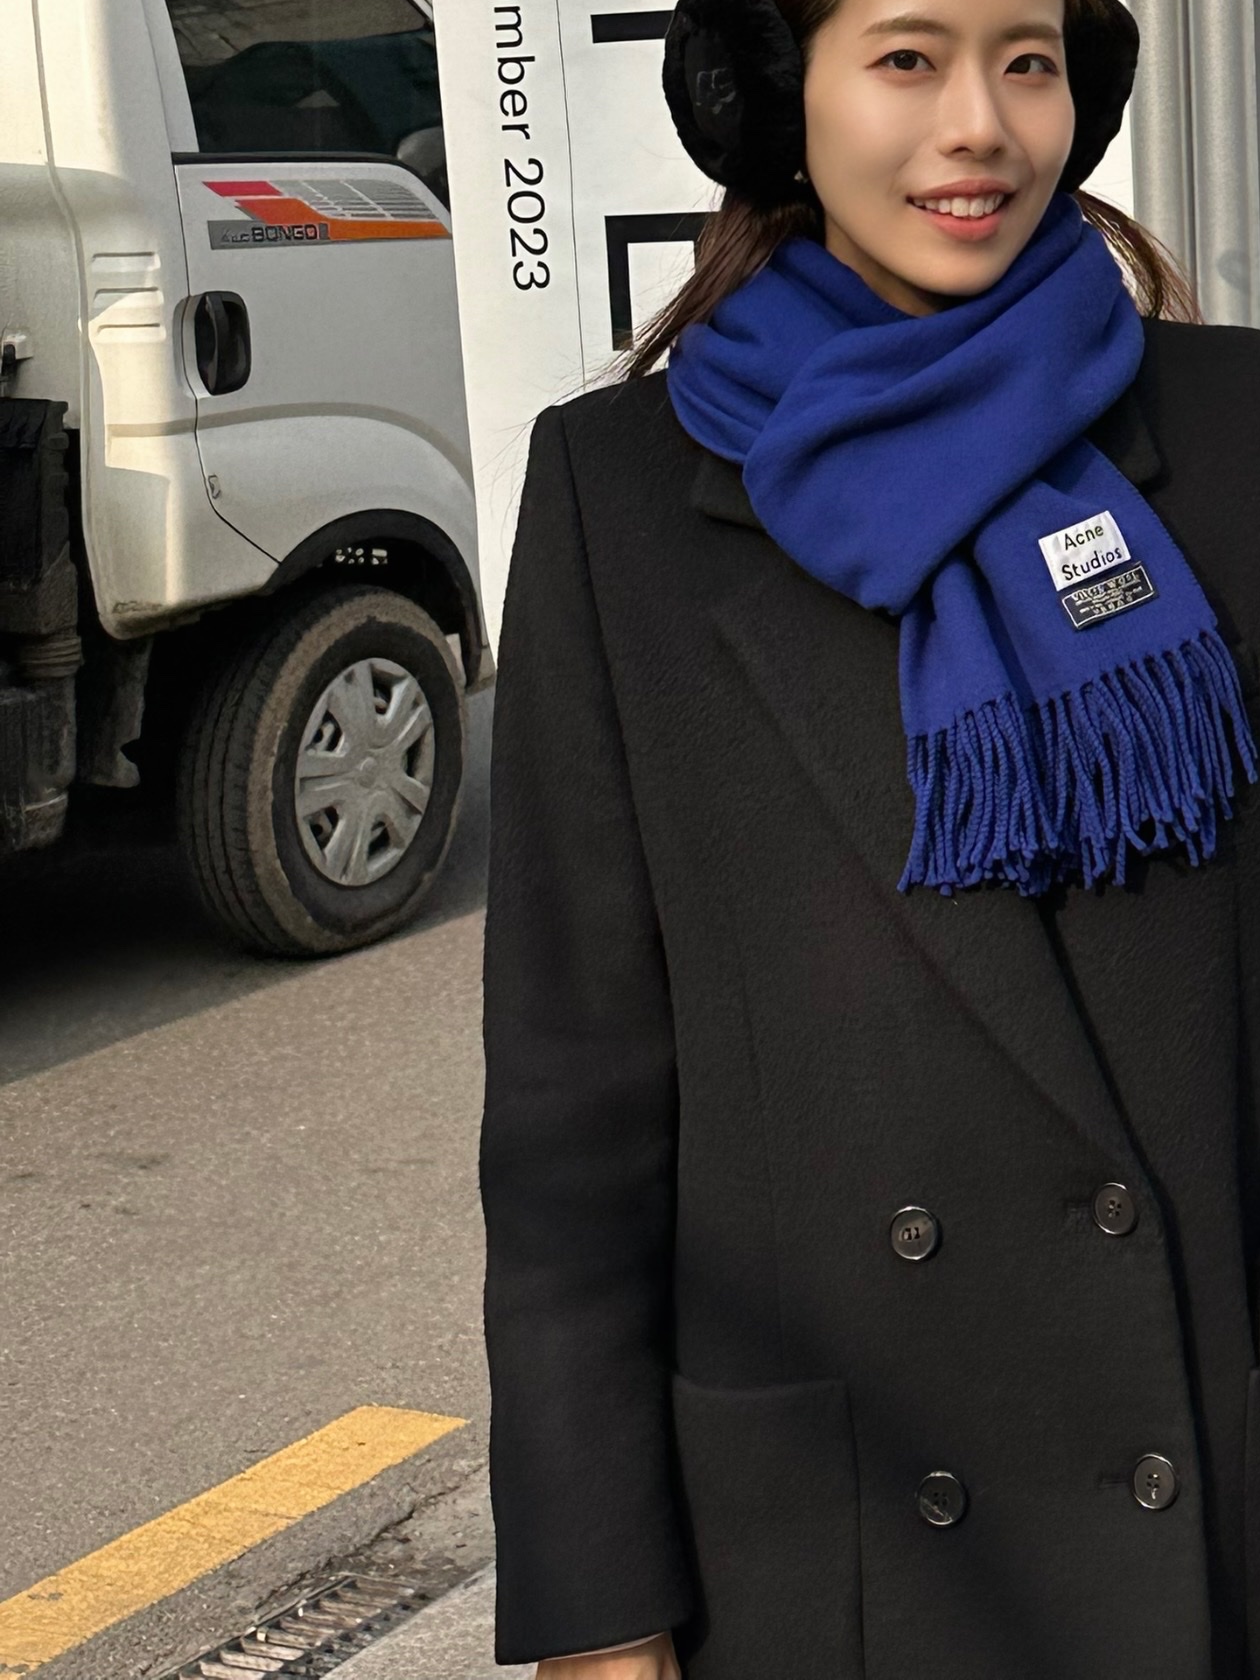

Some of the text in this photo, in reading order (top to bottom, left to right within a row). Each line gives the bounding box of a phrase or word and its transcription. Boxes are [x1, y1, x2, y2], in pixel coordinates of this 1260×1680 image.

[504, 157, 551, 291] 2023
[1064, 525, 1104, 550] Acne
[1062, 547, 1122, 581] Studios
